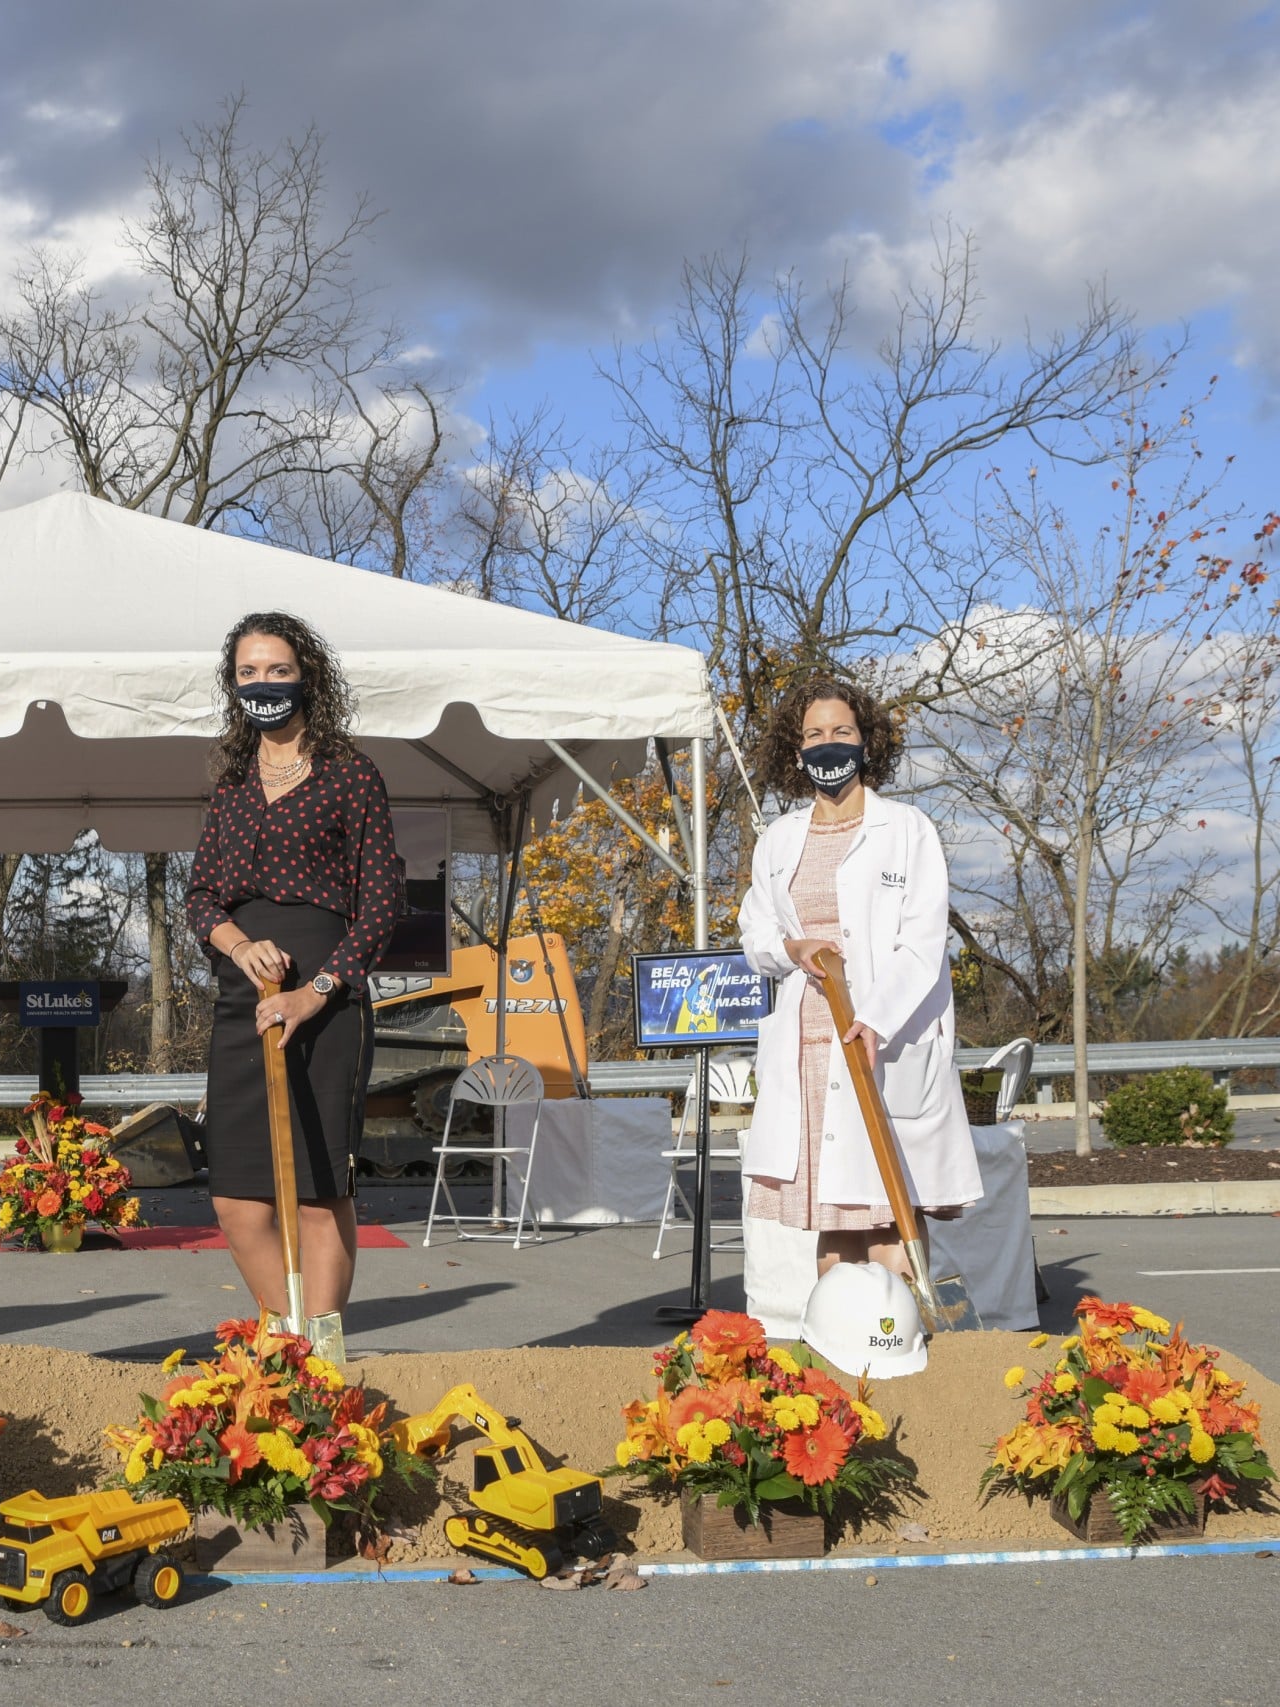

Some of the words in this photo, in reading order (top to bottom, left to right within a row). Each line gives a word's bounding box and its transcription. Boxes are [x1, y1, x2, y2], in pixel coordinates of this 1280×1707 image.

[650, 966, 674, 979] BE
[675, 965, 690, 977] A
[650, 978, 692, 990] HERO
[717, 974, 762, 987] WEAR
[749, 985, 762, 996] A
[715, 996, 762, 1008] MASK
[868, 1335, 904, 1351] Boyle
[102, 1528, 117, 1542] CAT
